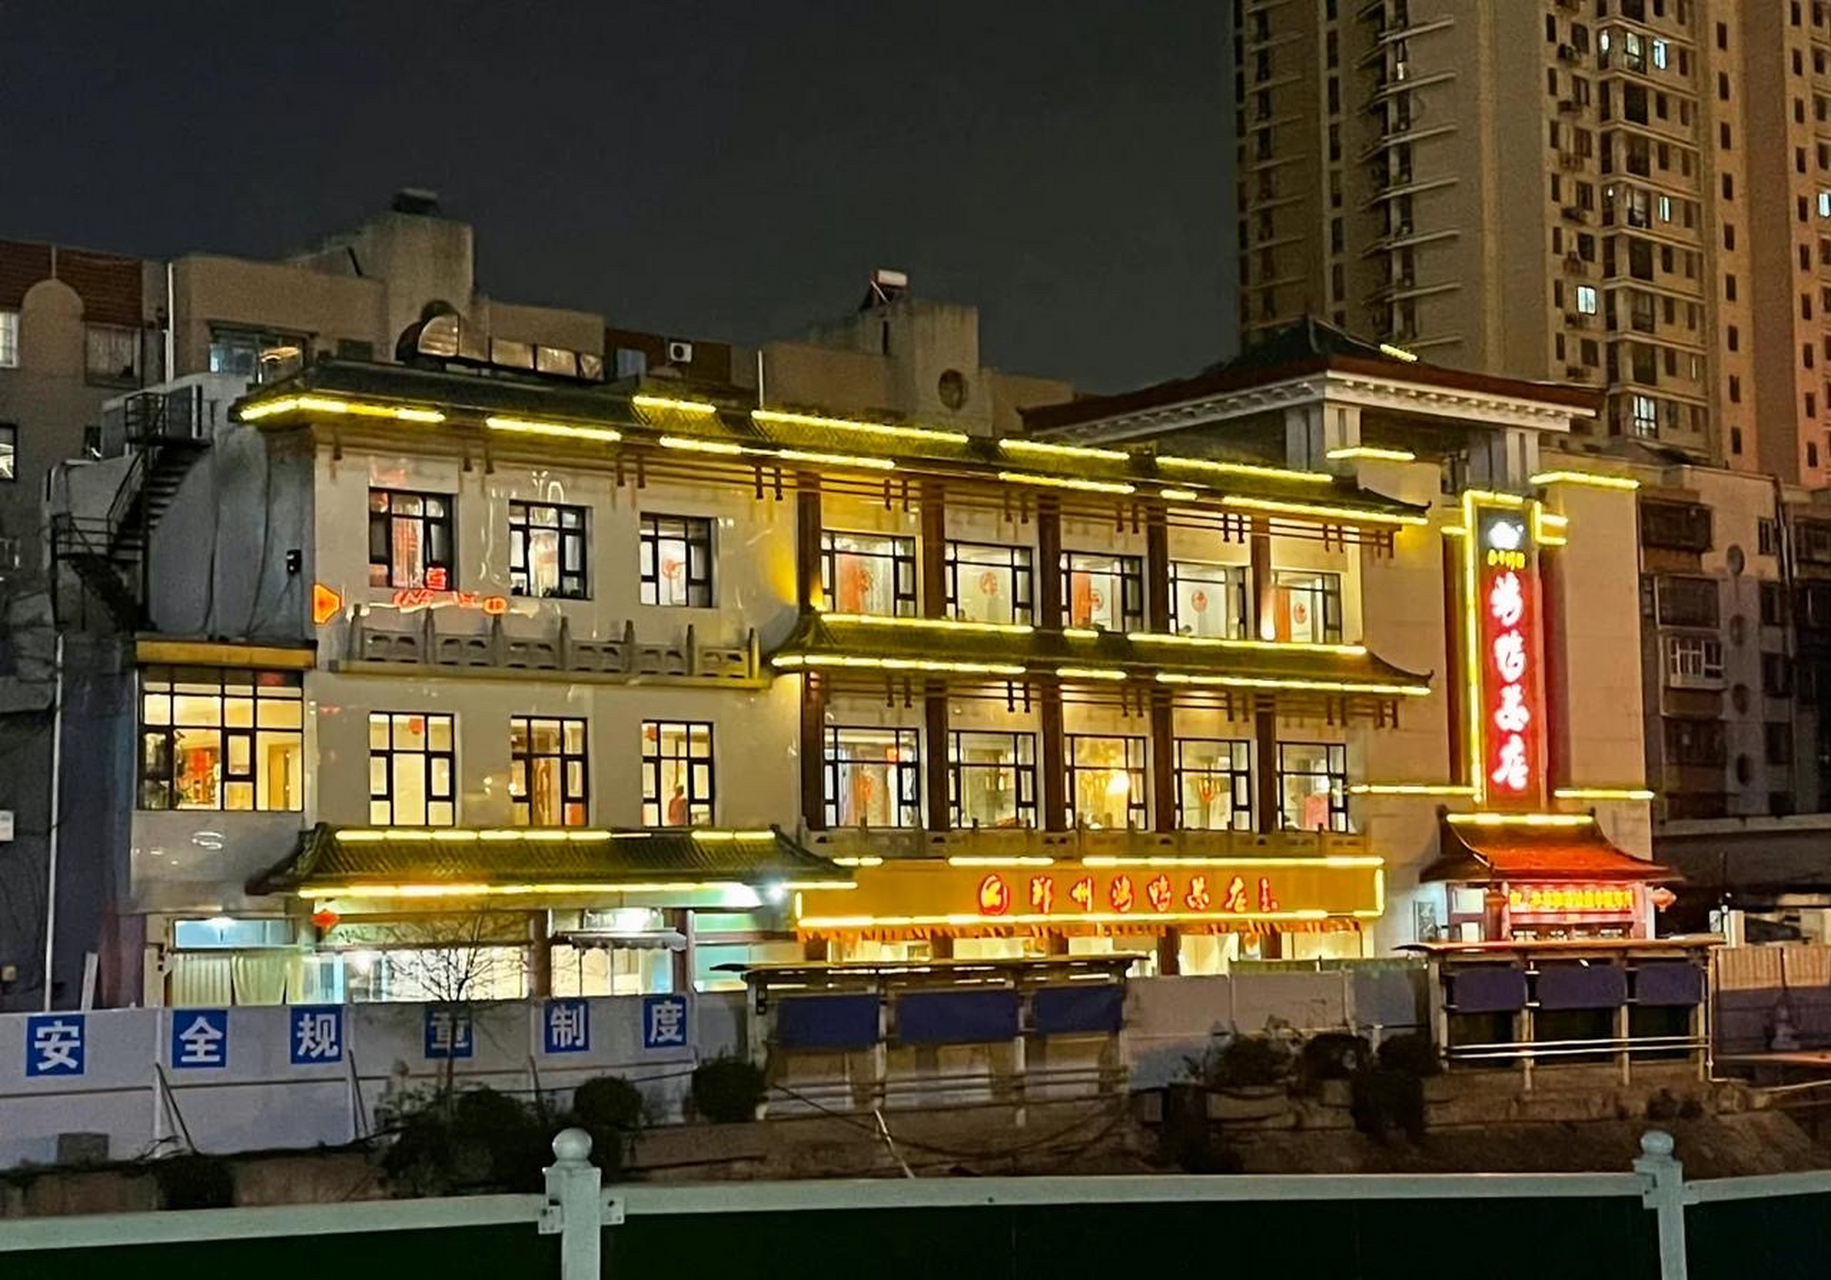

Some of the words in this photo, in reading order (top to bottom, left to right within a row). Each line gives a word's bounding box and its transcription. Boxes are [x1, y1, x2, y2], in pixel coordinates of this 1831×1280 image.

[34, 1002, 686, 1071] 安全规章制度
